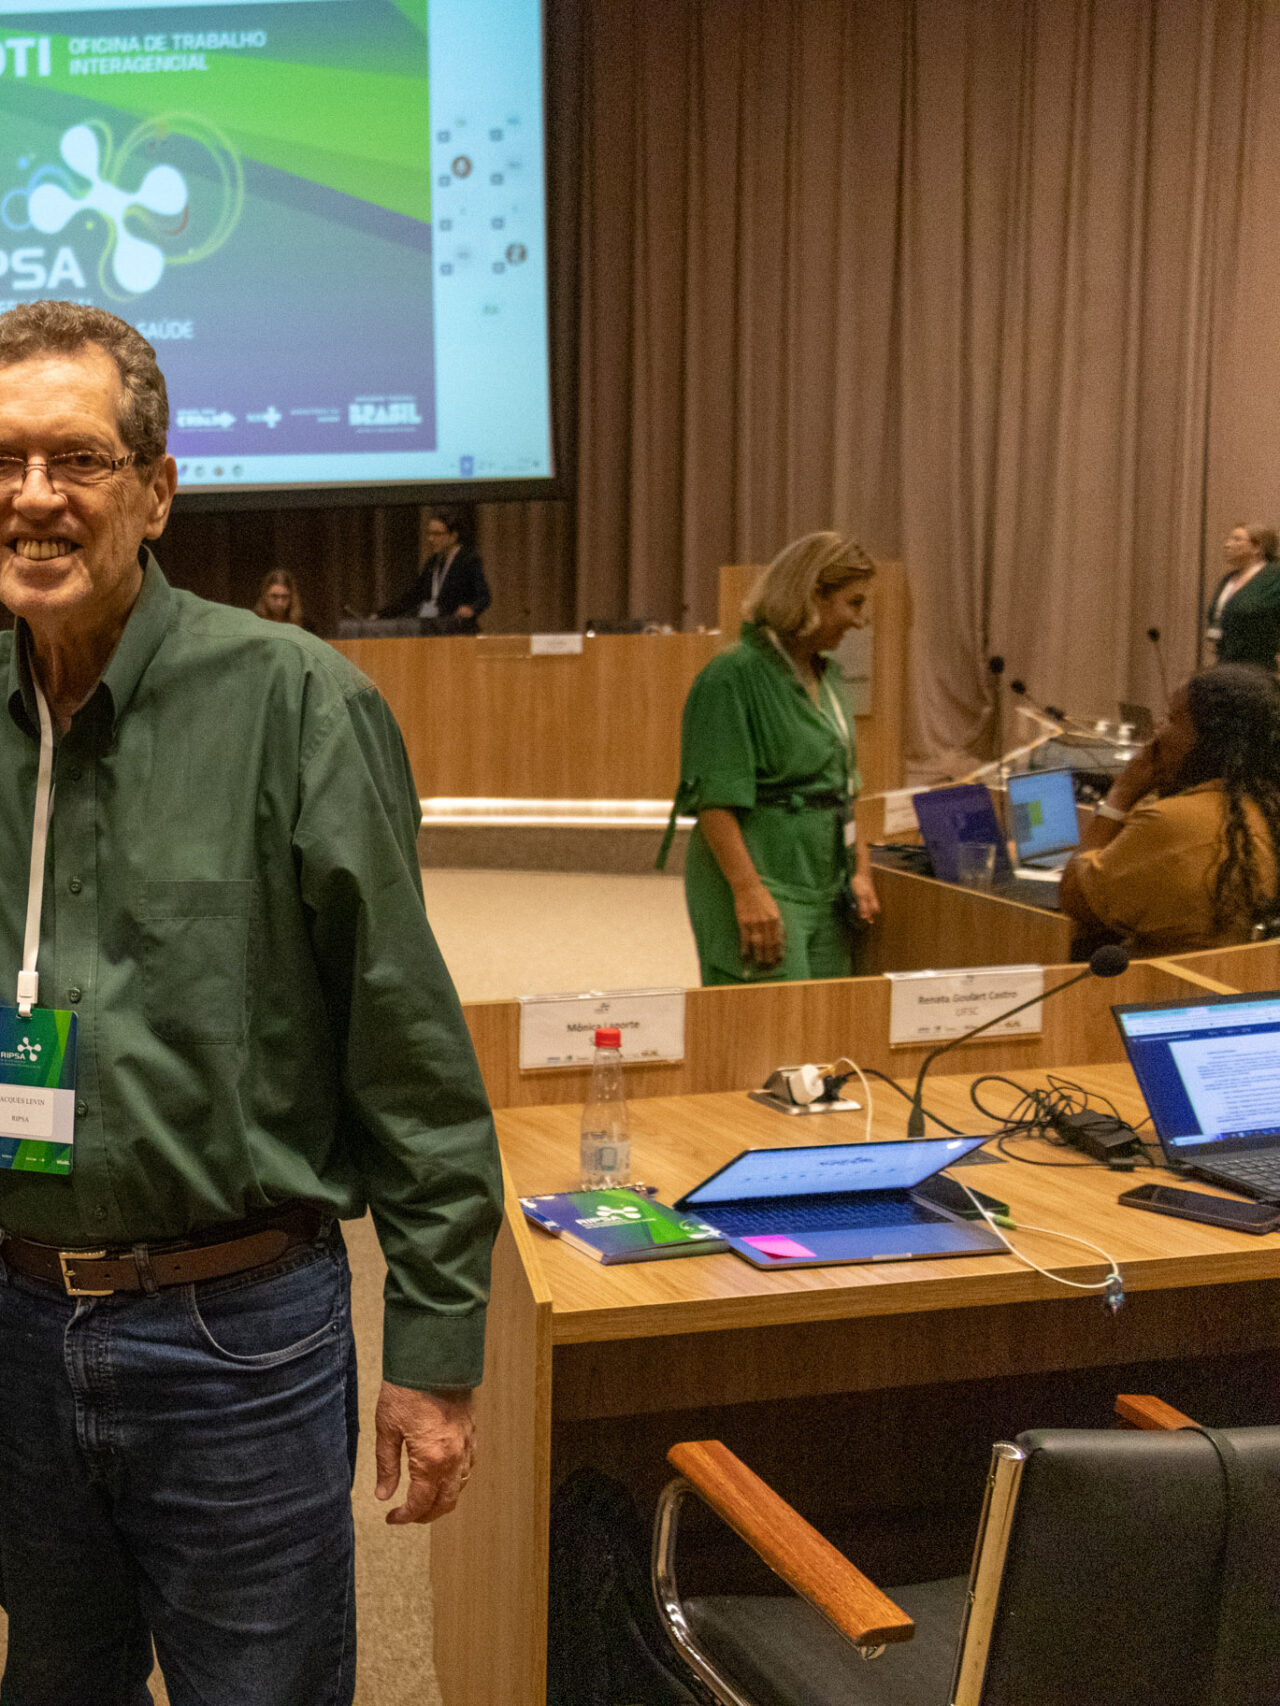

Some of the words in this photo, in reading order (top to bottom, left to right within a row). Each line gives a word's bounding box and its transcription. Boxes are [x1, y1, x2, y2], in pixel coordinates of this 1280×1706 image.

[69, 36, 140, 54] OFICINA
[143, 35, 168, 52] DE
[172, 30, 267, 50] TRABALHO
[69, 53, 208, 75] INTERAGENCIAL
[0, 1051, 26, 1060] RIPSA
